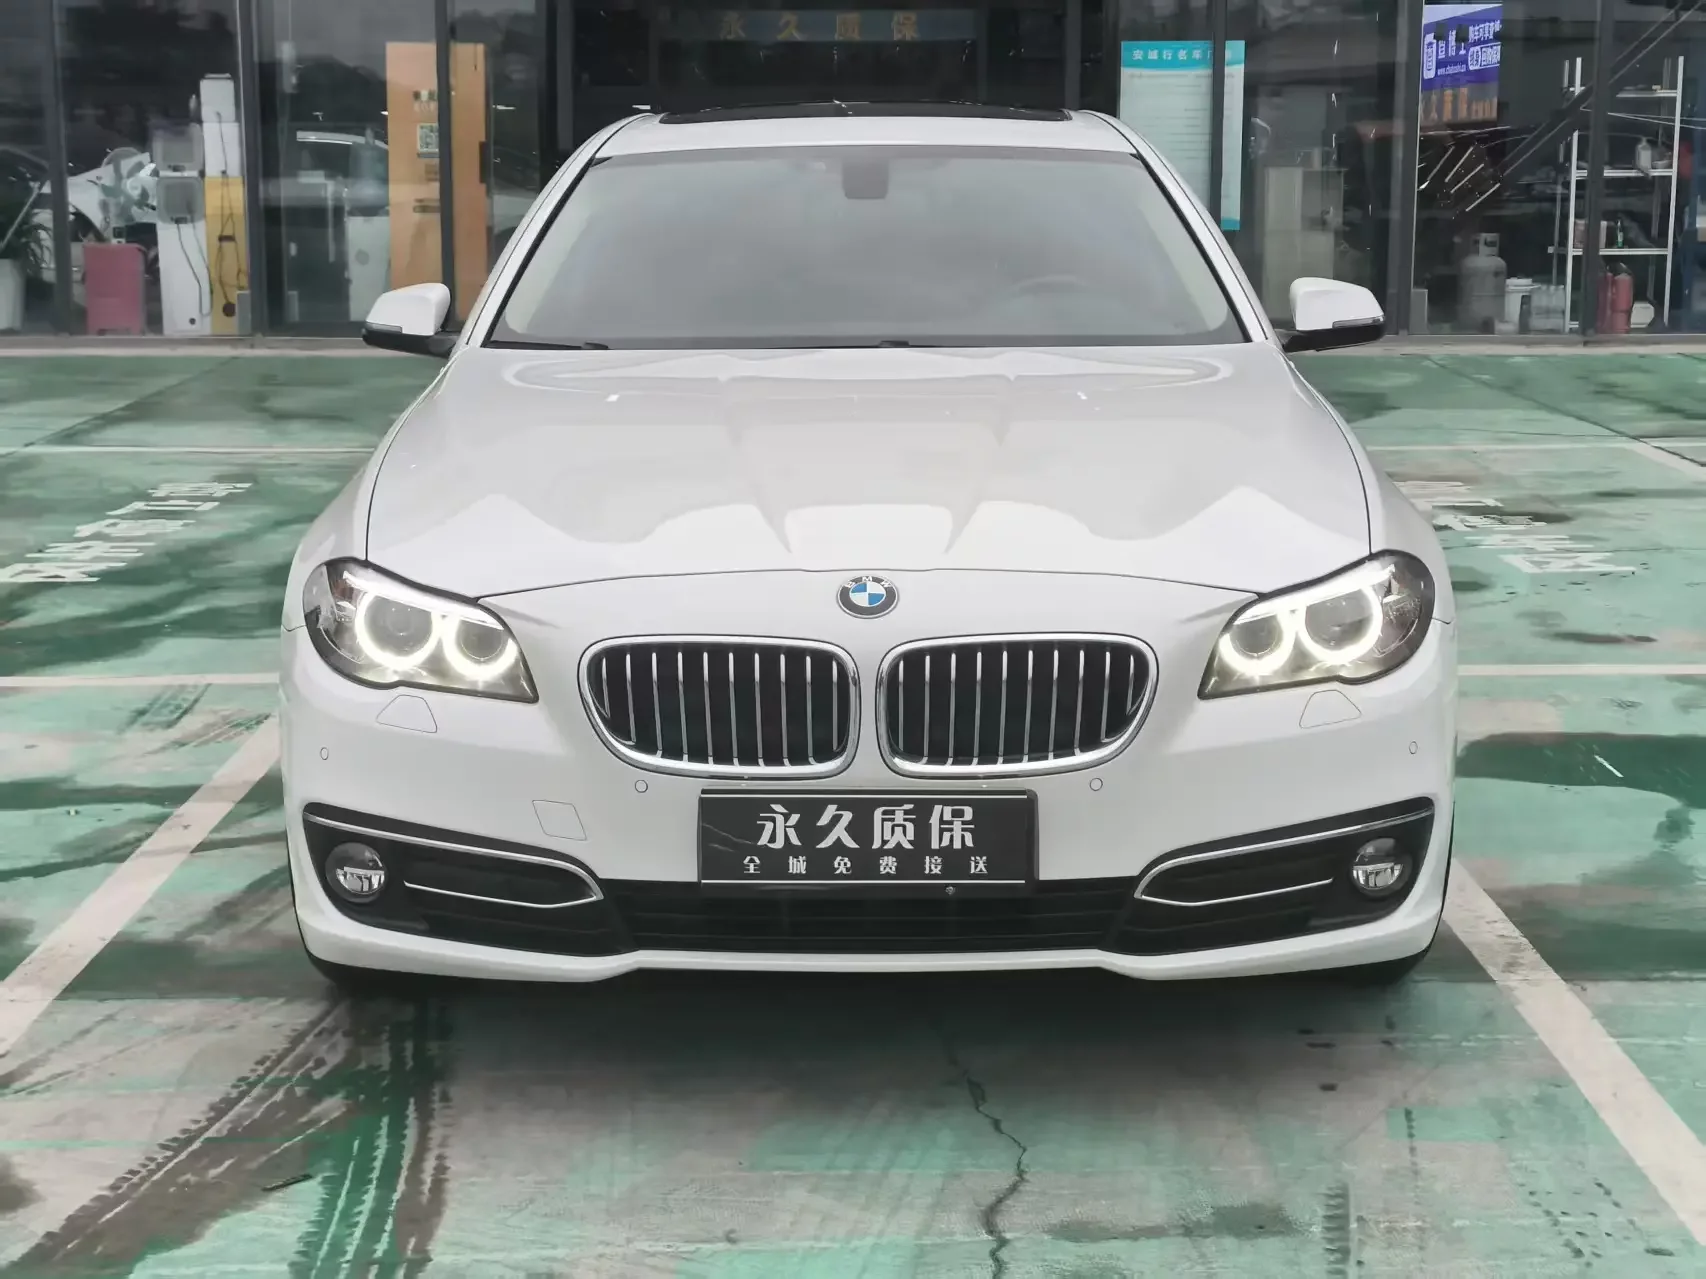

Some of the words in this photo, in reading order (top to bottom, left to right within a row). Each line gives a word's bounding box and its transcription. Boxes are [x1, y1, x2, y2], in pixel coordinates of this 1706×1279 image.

[843, 575, 892, 588] BMW
[756, 803, 975, 850] 永久质保
[743, 855, 988, 875] 全城免费接送
